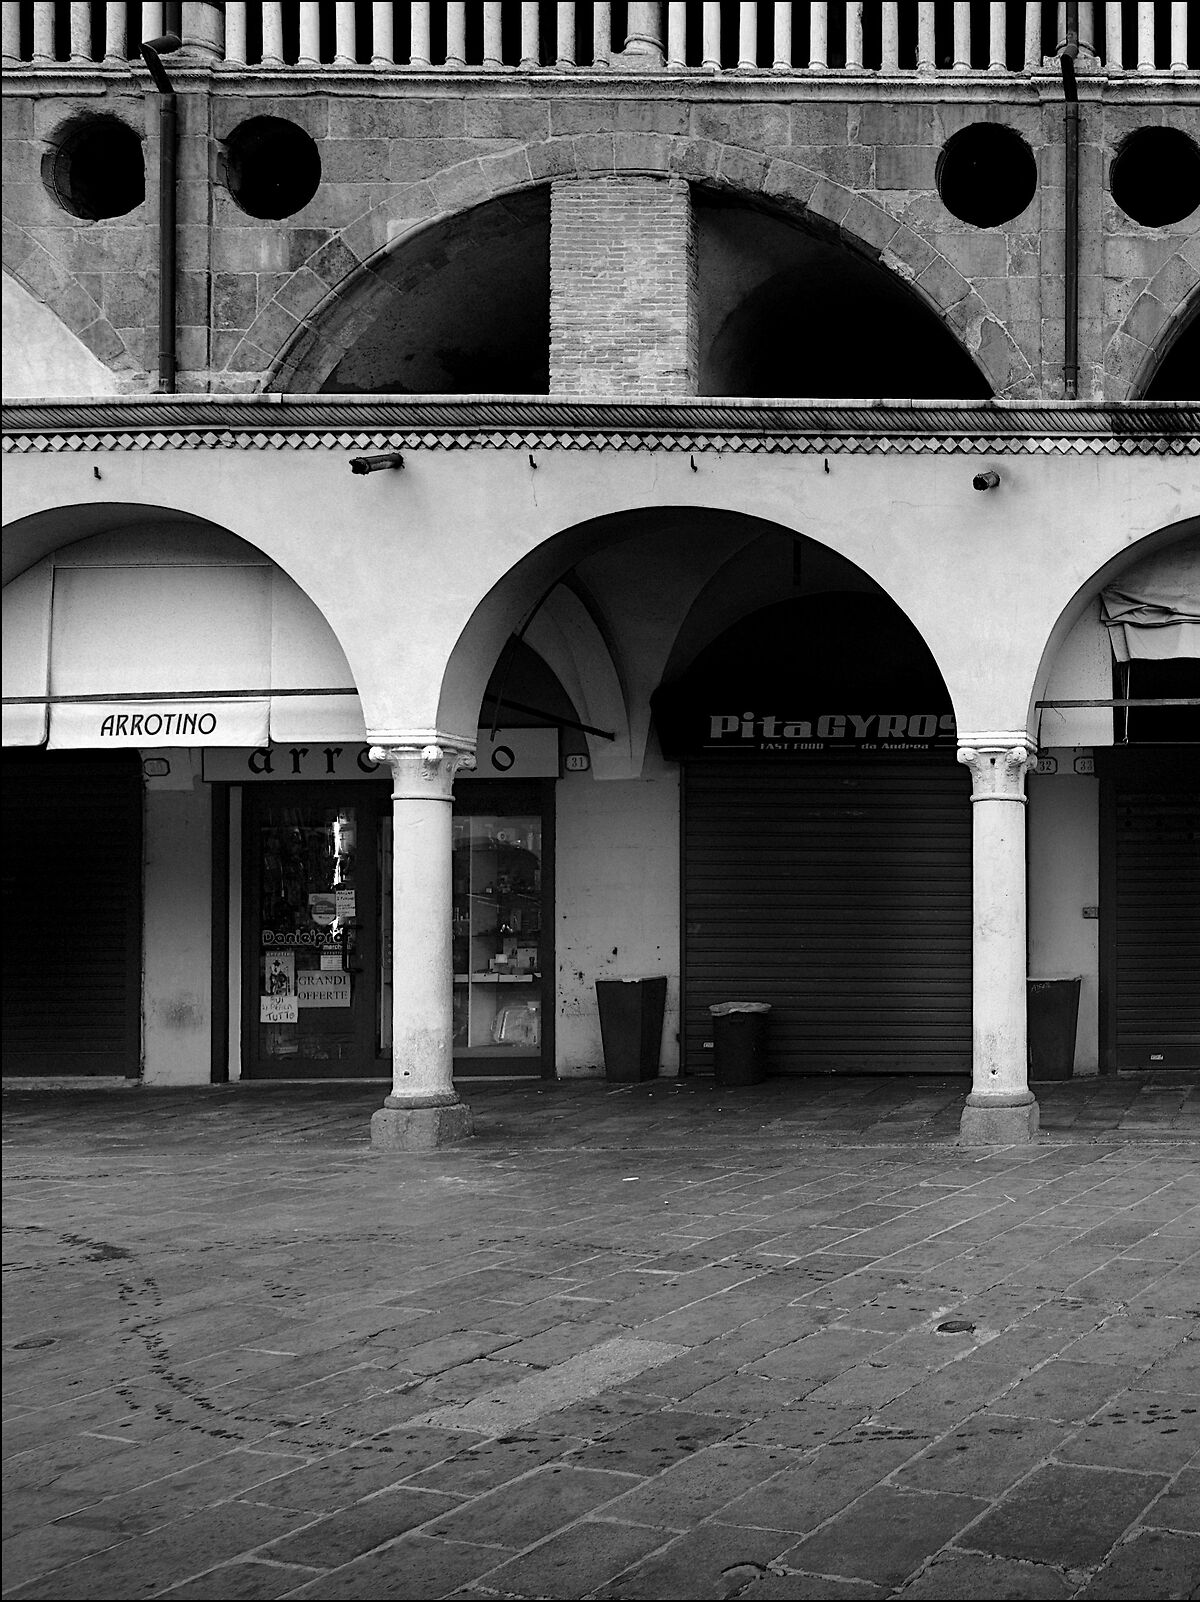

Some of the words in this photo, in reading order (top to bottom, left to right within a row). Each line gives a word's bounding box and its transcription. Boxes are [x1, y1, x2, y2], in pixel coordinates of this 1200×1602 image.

[100, 712, 217, 737] ARROTINO
[760, 742, 789, 750] FAST
[793, 742, 825, 750] FOOD
[860, 742, 877, 750] da
[881, 742, 930, 750] Andrea
[248, 745, 515, 774] arroo
[571, 757, 584, 767] 31
[1039, 760, 1051, 771] 32
[298, 975, 347, 986] GRANDI
[298, 991, 348, 1000] OFFERTE
[265, 1011, 296, 1022] TUTTO
